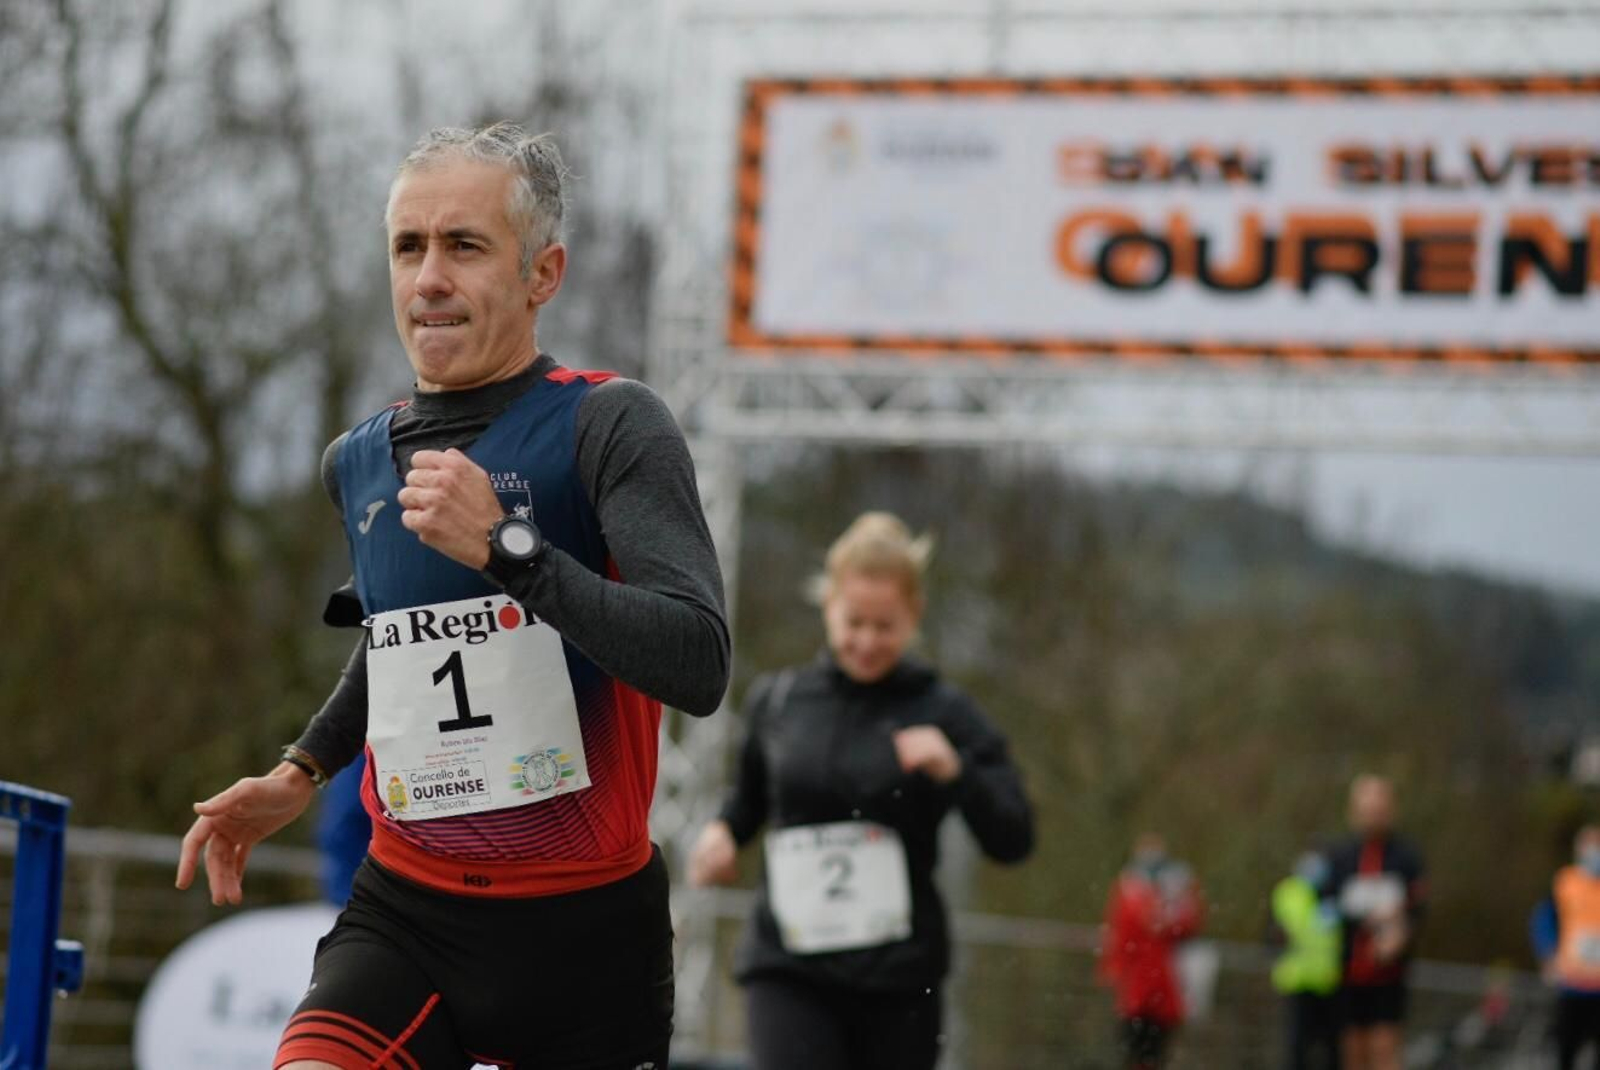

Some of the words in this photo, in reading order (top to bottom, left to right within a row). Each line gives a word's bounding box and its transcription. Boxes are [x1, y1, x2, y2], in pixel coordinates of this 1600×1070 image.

[490, 472, 517, 481] CLUB
[493, 480, 530, 489] RENSE
[368, 618, 401, 650] La
[432, 651, 493, 733] 1
[410, 768, 454, 783] Concello
[457, 766, 470, 777] de
[412, 779, 485, 800] OURENSE
[819, 854, 857, 901] 2
